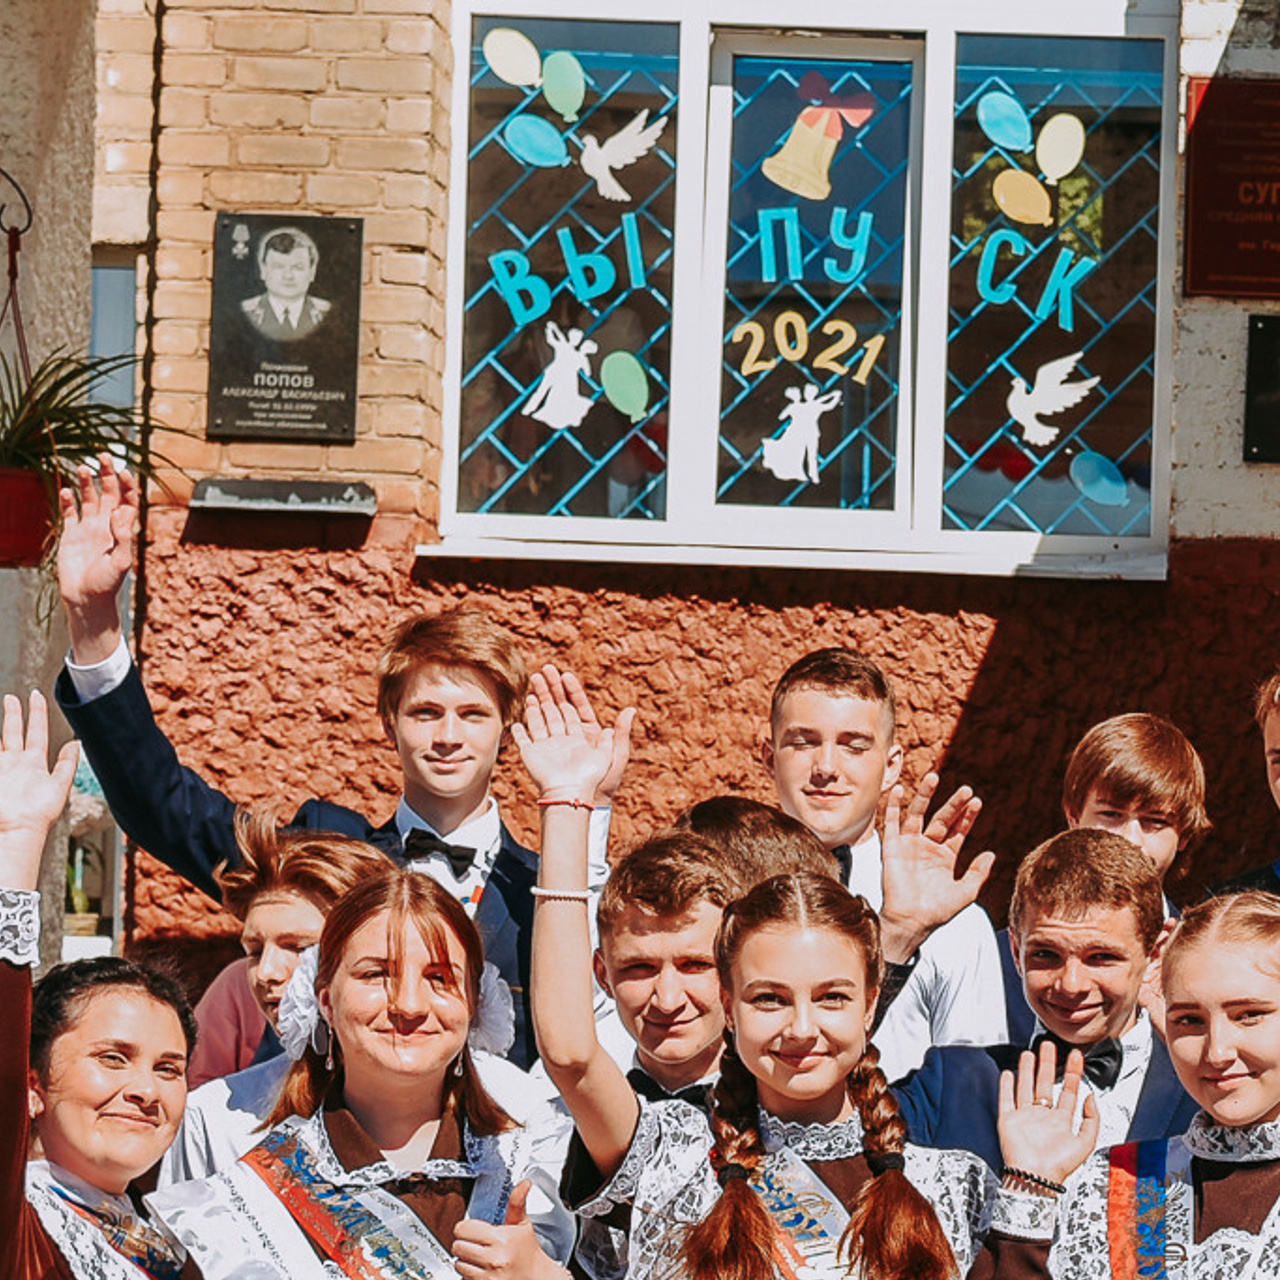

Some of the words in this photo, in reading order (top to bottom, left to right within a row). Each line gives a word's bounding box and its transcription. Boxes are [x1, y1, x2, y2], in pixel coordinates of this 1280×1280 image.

[732, 310, 886, 386] 2021
[253, 373, 314, 389] ПОПОВ
[222, 387, 279, 400] АЛЕКСАНДР
[281, 389, 346, 401] ВАСИЛЬЕВИЧ
